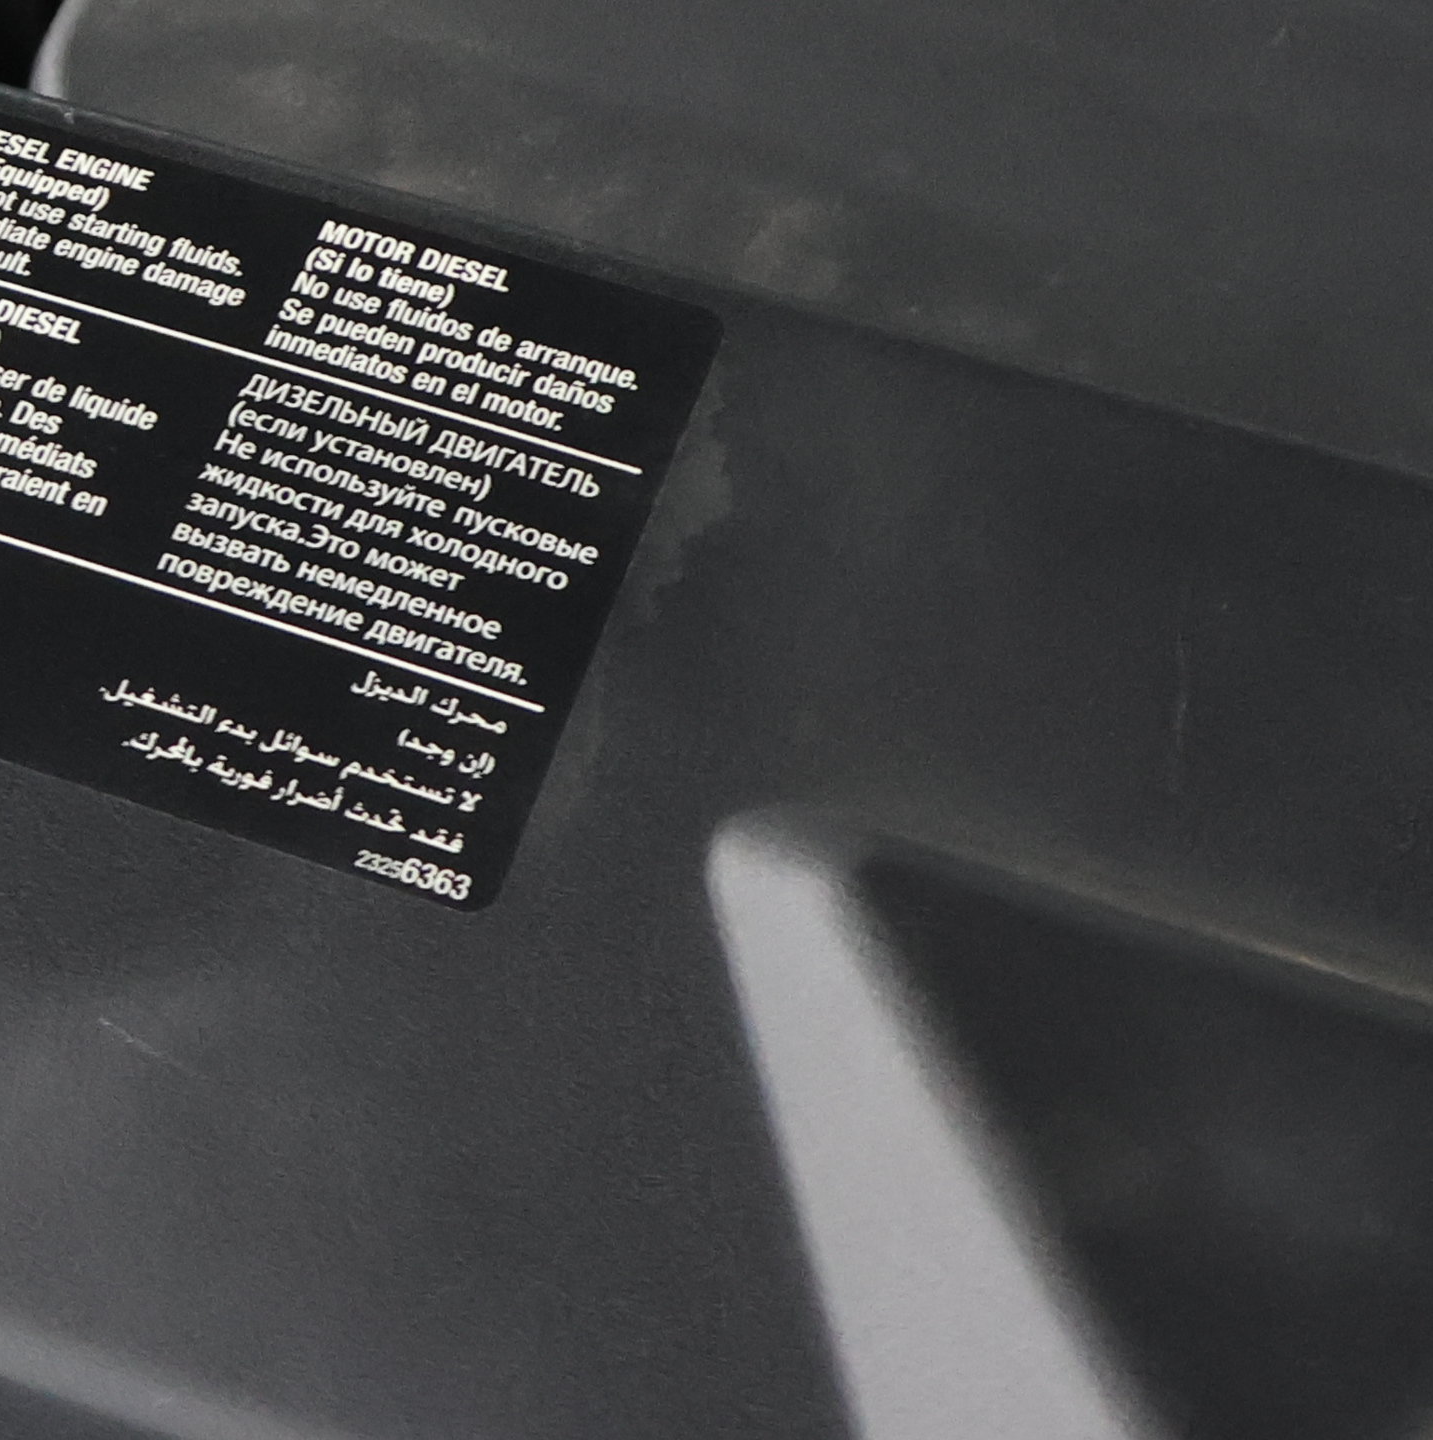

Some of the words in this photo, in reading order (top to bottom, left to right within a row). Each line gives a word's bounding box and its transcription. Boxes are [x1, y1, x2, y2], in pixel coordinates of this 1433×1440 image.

[53, 147, 156, 192] ENGINE
[16, 198, 67, 226] use
[66, 212, 167, 258] starting
[167, 236, 244, 278] fluids.
[52, 238, 141, 276] engine
[141, 260, 247, 307] damage
[304, 245, 347, 275] (Si
[344, 256, 375, 283] lo
[376, 265, 456, 310] tiene)
[316, 219, 417, 265] MOTOR
[416, 247, 510, 293] DIESEL
[277, 297, 316, 326] Se
[313, 312, 417, 356] pueden
[414, 341, 532, 388] producir
[532, 372, 616, 415] daños
[290, 270, 331, 300] No
[332, 286, 383, 315] use
[384, 297, 475, 342] fluidos
[476, 325, 513, 353] de
[514, 339, 639, 391] arranque.
[8, 399, 64, 436] Des
[30, 375, 68, 404] de
[67, 384, 159, 431] liquide
[263, 323, 409, 385] inmediatos
[410, 371, 448, 397] en
[450, 381, 481, 405] el
[479, 391, 565, 432] motor.
[227, 399, 309, 443] (если
[307, 429, 492, 503] установлен)
[237, 372, 431, 446] ДИЗЕЛЬНЫЙ
[426, 429, 601, 498] ДВИГАТЕЛЬ
[70, 490, 109, 517] en
[197, 462, 345, 521] жидкости
[341, 508, 405, 539] для
[405, 525, 569, 591] холодного
[213, 428, 257, 461] Не
[259, 447, 447, 519] используйте
[452, 505, 599, 566] пусковые
[171, 521, 292, 574] вызвать
[295, 560, 503, 641] немедленное
[363, 547, 466, 592] может
[156, 552, 365, 632] повреждение
[362, 619, 528, 686] двигателя.
